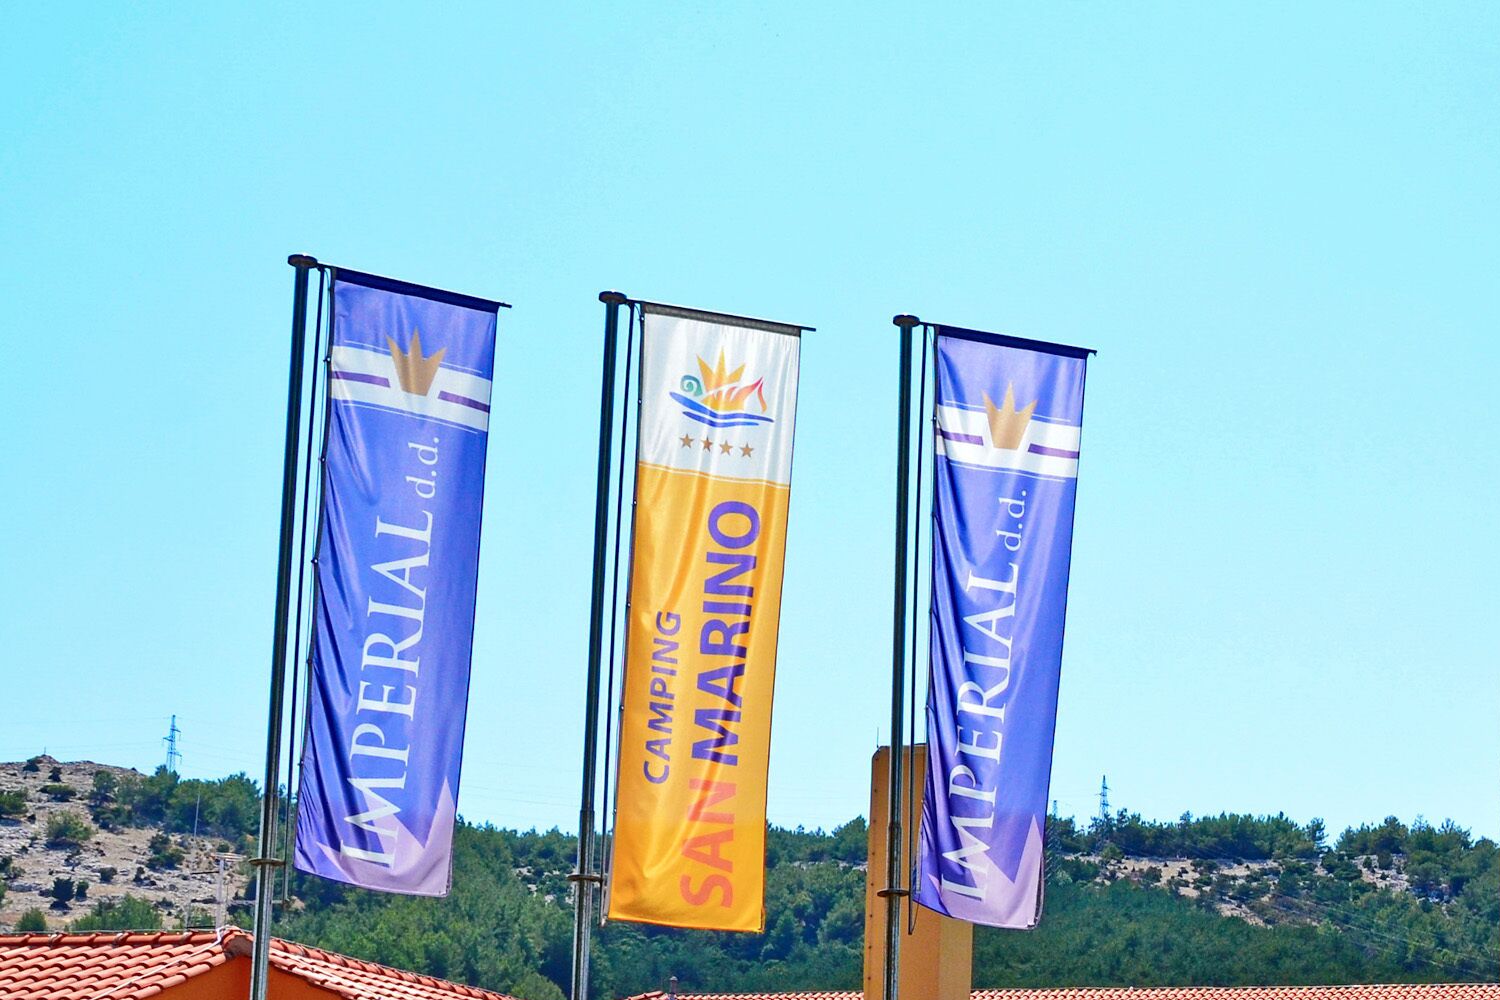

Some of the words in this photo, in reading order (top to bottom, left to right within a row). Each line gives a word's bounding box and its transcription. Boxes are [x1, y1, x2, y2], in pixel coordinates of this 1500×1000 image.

[340, 509, 435, 870] IMPERIAL
[415, 436, 441, 500] d.d.
[643, 611, 682, 786] CAMPING
[691, 500, 761, 768] MARINO
[941, 562, 1019, 902] IMPERIAL
[997, 488, 1028, 552] d.d.
[681, 777, 736, 910] SAN
